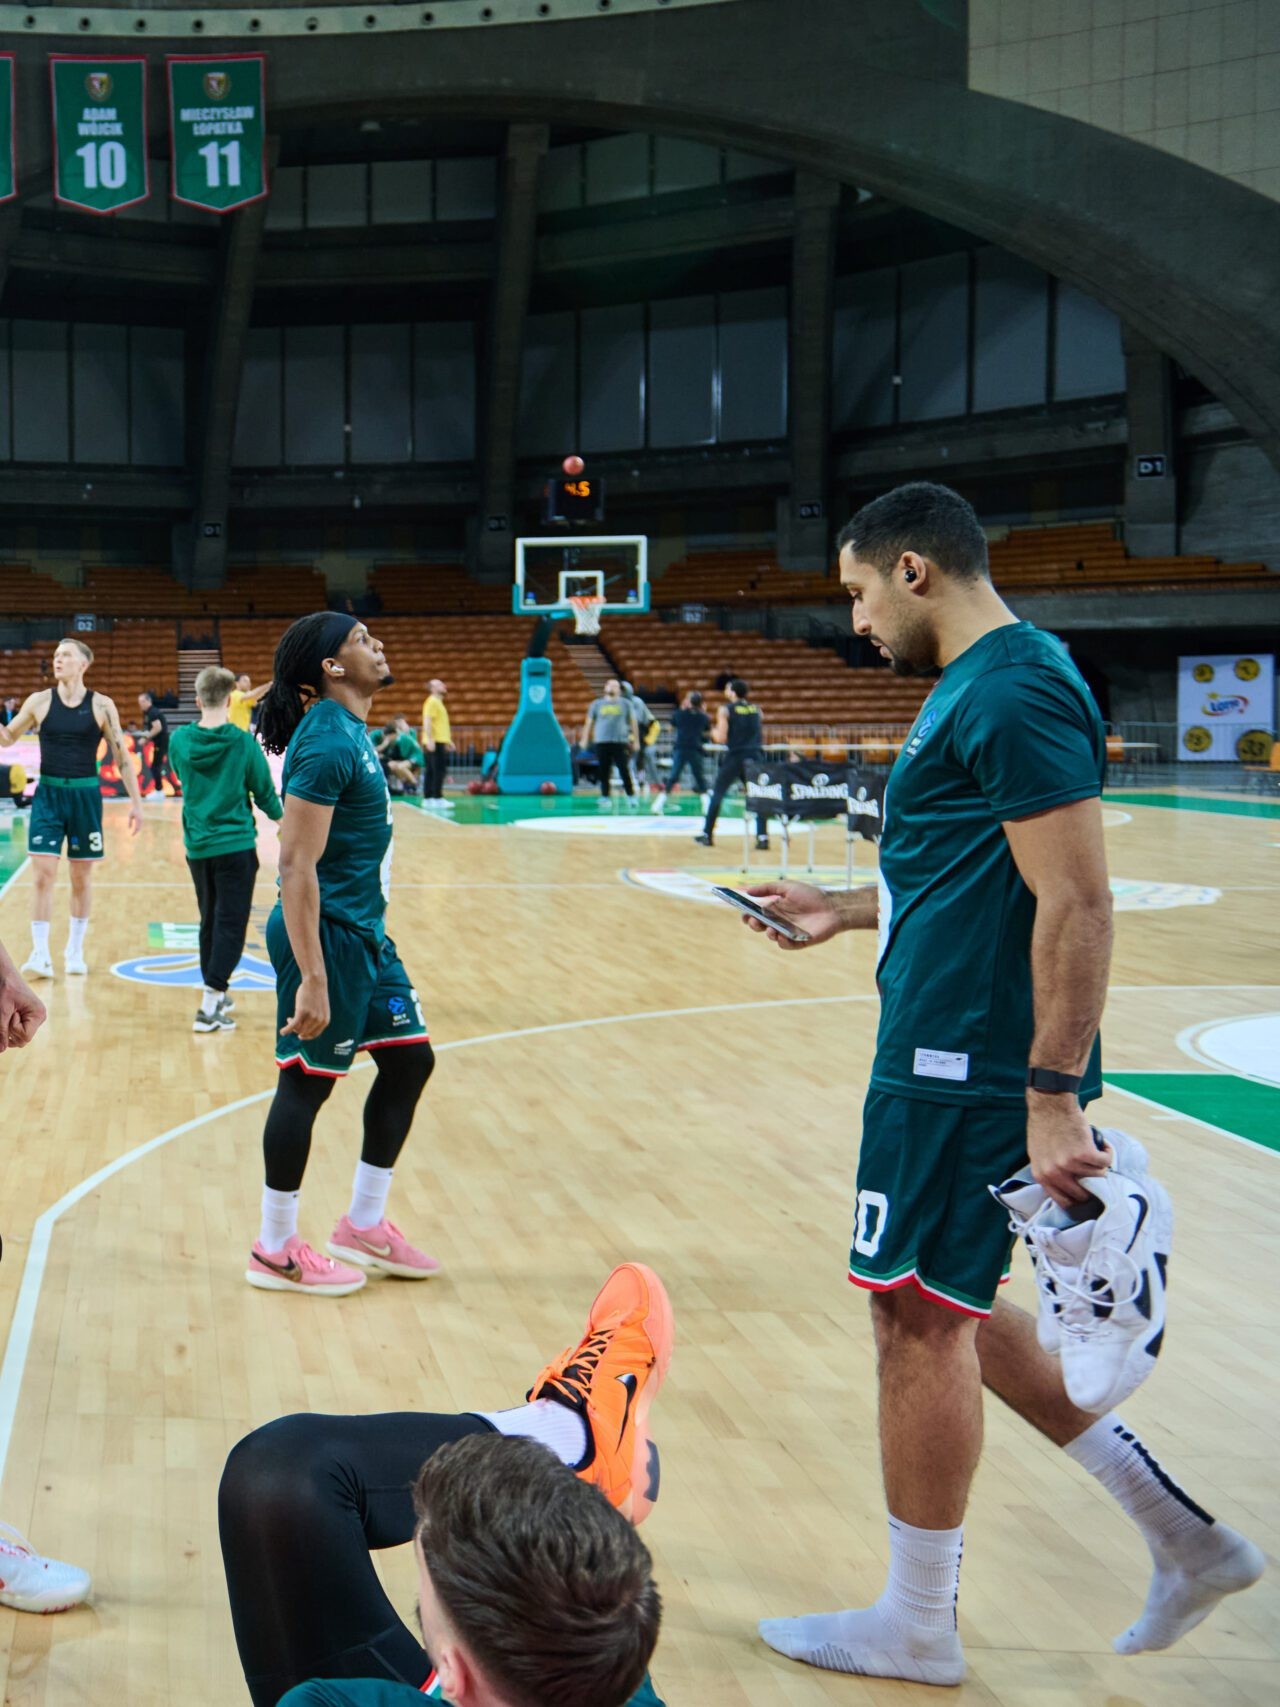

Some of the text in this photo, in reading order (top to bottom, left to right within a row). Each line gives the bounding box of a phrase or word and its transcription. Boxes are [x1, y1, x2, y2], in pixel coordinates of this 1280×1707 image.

[76, 141, 126, 189] 10
[198, 140, 241, 187] 11
[1140, 461, 1161, 473] D1
[89, 831, 103, 852] 3
[850, 1189, 889, 1258] 0
